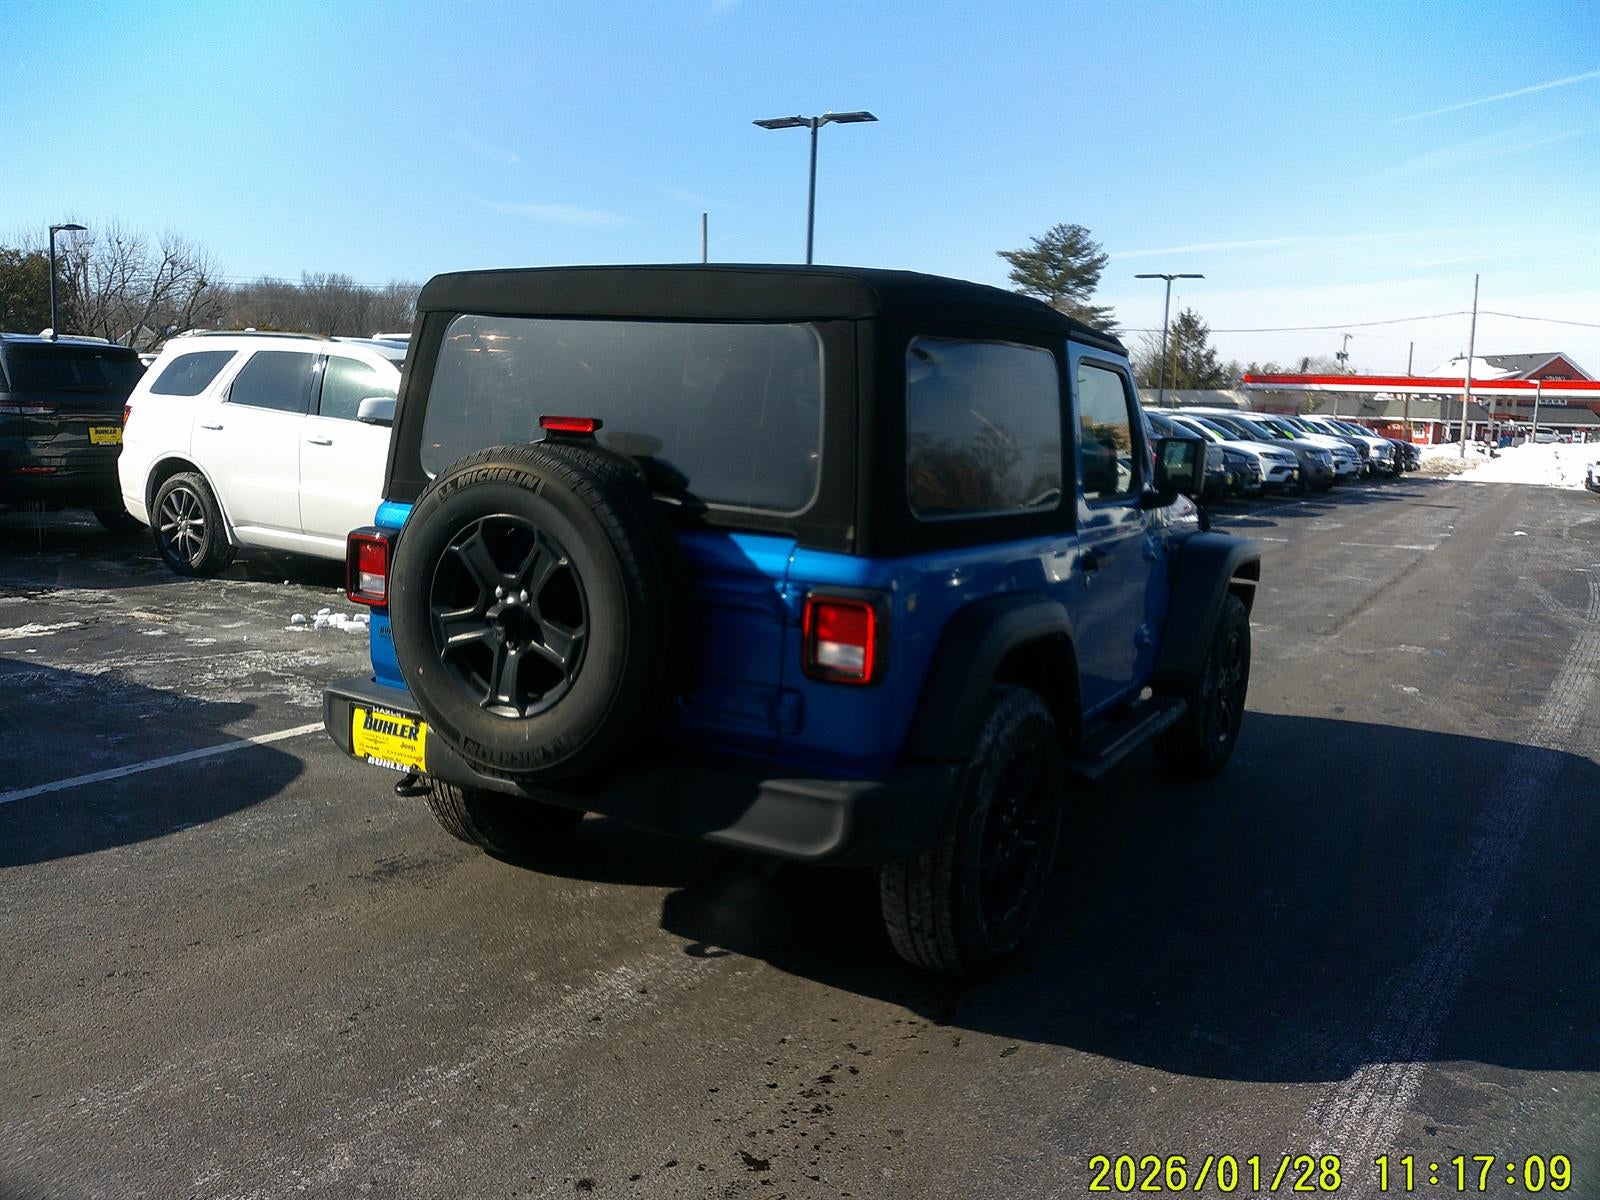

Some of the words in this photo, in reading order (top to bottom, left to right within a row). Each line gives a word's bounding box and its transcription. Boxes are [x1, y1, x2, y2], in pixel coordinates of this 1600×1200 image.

[456, 467, 537, 490] MICHELIN
[363, 715, 419, 742] BUHLER
[367, 756, 410, 773] BUHLER
